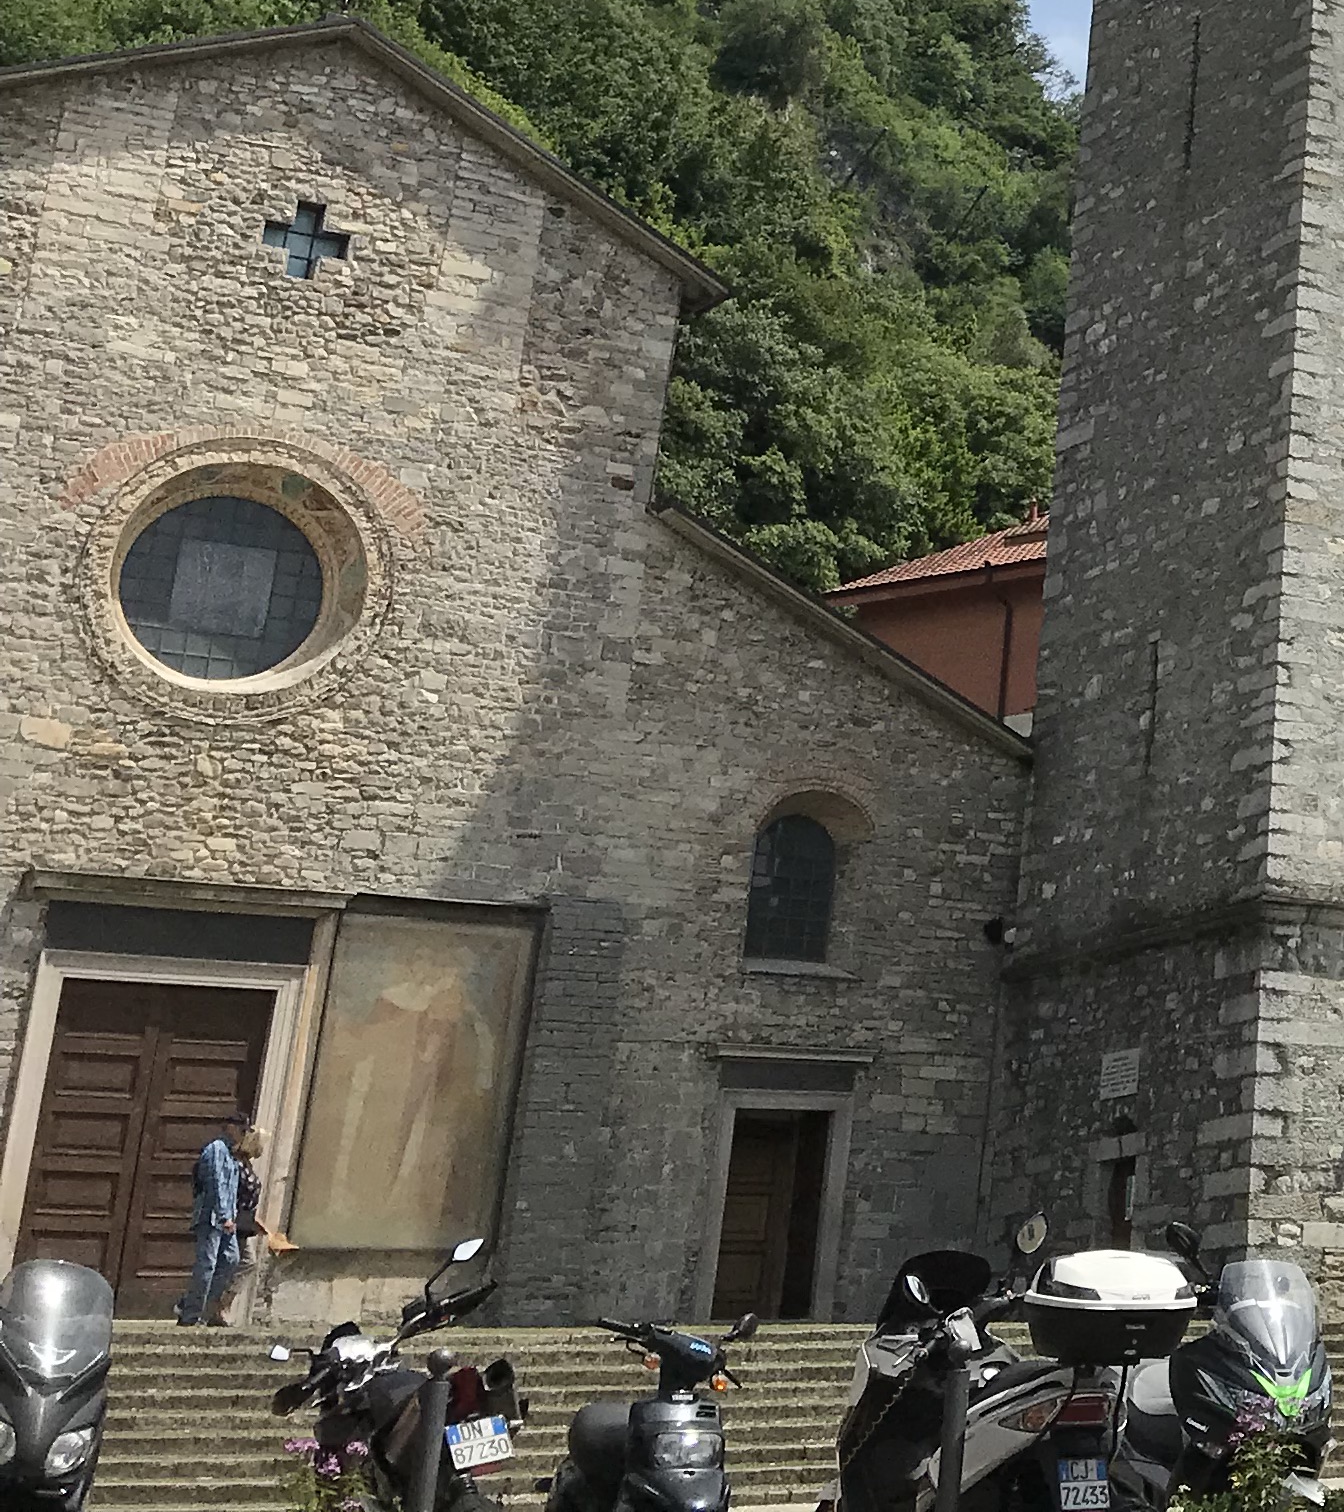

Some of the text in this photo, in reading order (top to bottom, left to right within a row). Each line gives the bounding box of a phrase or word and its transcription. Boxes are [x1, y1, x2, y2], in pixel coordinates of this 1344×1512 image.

[460, 1421, 484, 1441] DN
[453, 1438, 509, 1465] 87230
[1071, 1461, 1089, 1480] CJ
[1062, 1485, 1108, 1506] 72433
